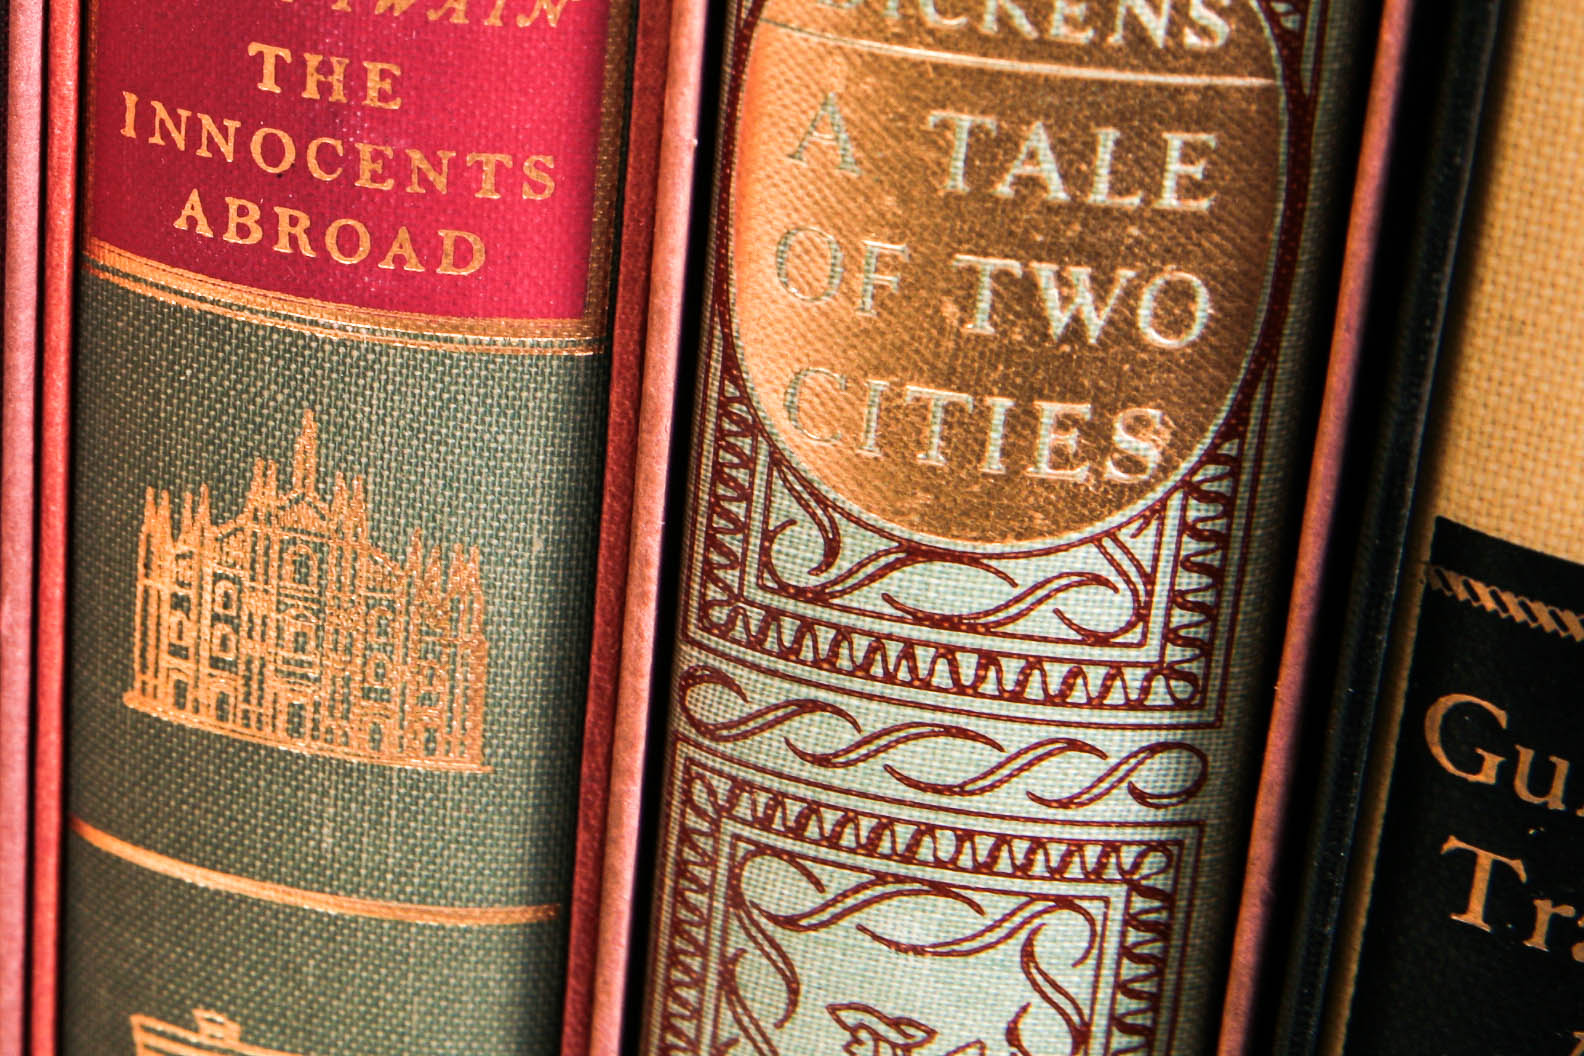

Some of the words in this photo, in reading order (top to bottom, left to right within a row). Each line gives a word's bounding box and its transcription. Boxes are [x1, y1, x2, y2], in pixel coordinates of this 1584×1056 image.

[248, 41, 403, 110] THE
[120, 91, 556, 200] INNOCENTS
[789, 92, 862, 177] A
[928, 110, 1218, 212] TALE
[173, 188, 486, 276] ABROAD
[776, 225, 910, 319] OF
[952, 253, 1214, 349] TWO
[782, 366, 1171, 483] CITIES
[1424, 693, 1584, 817] Gu
